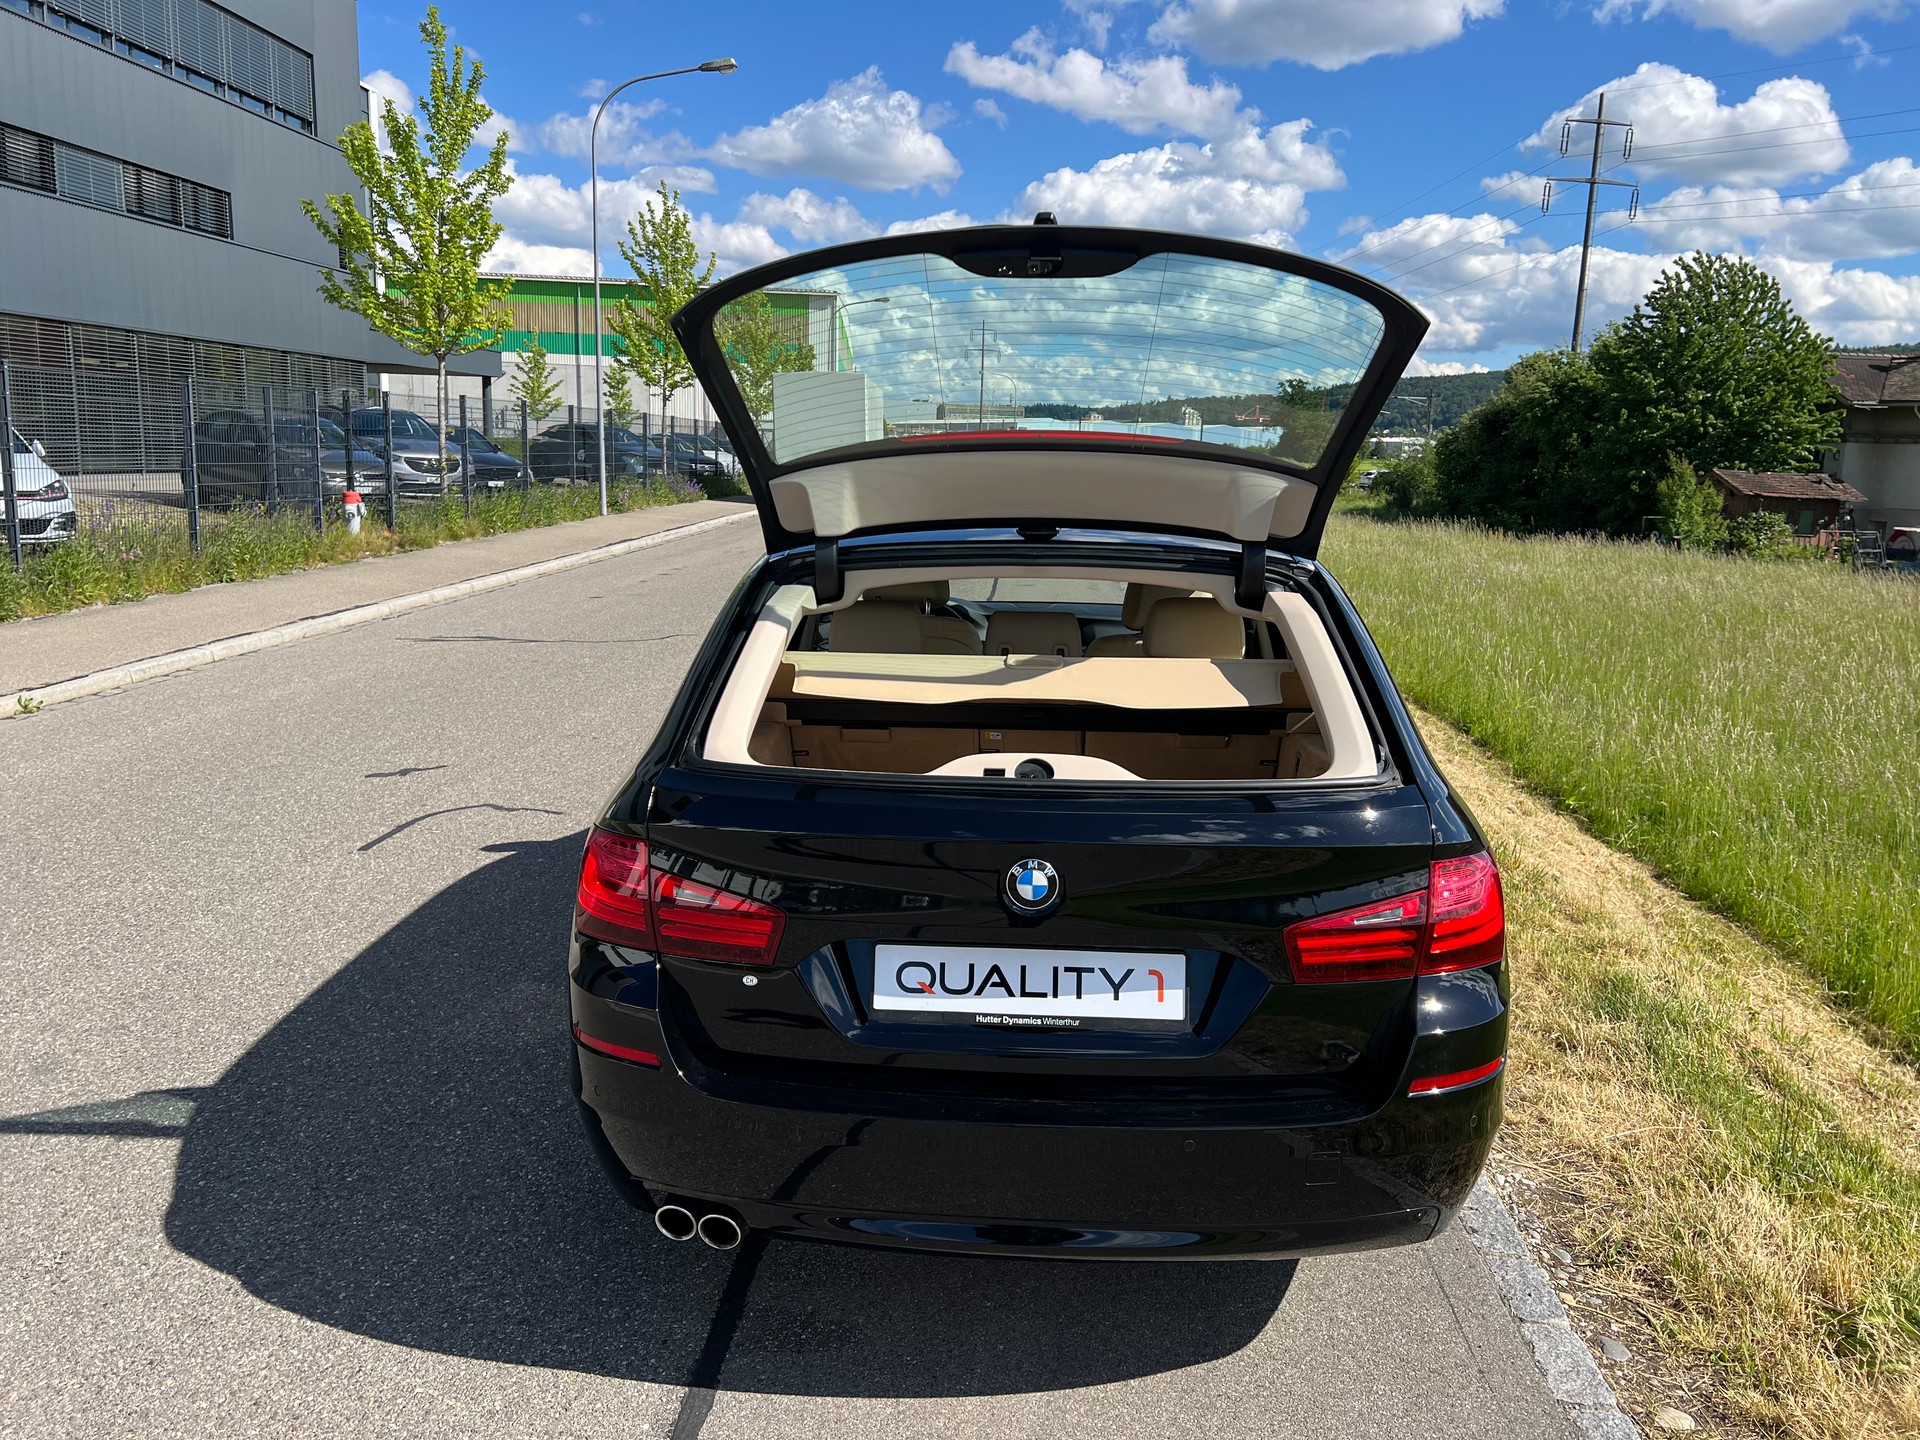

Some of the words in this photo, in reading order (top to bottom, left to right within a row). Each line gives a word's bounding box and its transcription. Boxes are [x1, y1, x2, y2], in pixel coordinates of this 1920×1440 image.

[1011, 860, 1055, 877] BMW
[895, 960, 1135, 1001] QUALITY
[1148, 969, 1164, 1003] 1
[976, 1014, 1002, 1024] Hutter
[1002, 1015, 1042, 1026] Dynamics
[1042, 1017, 1080, 1026] Winterthur
